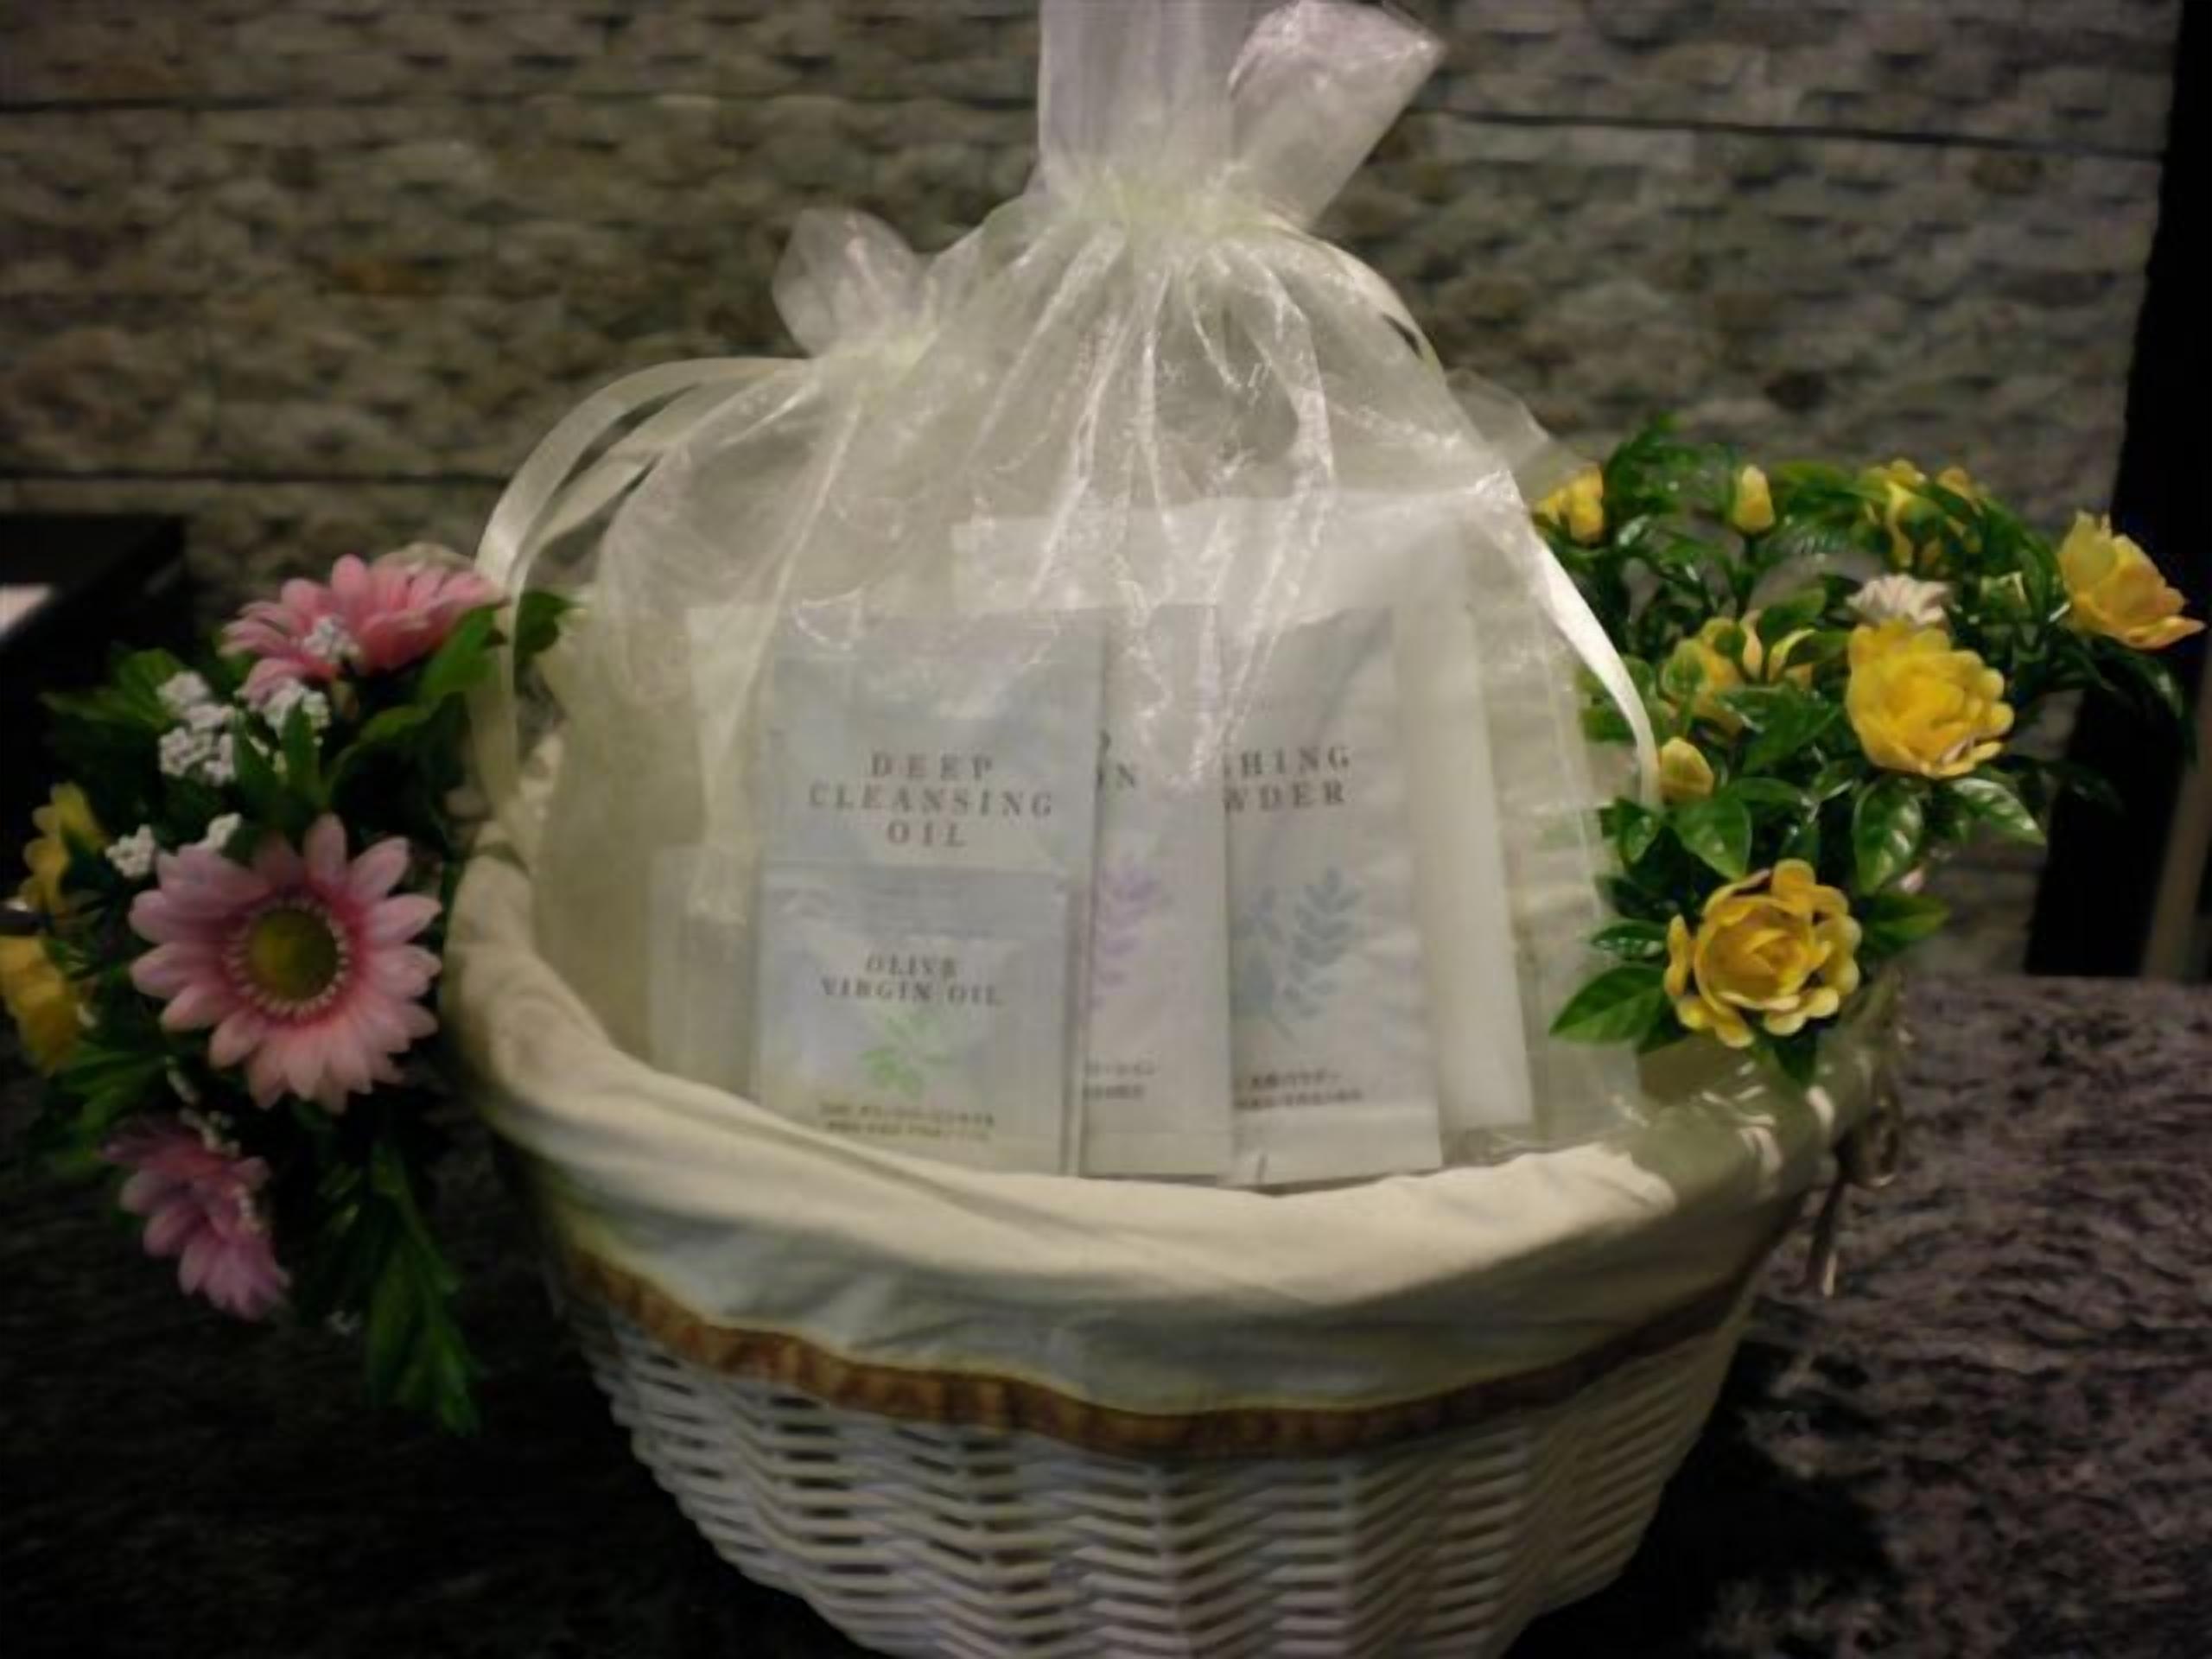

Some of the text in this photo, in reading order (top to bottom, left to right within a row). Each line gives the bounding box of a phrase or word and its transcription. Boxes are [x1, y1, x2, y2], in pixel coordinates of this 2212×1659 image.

[870, 750, 995, 782] DEEP
[1223, 746, 1350, 778] HING
[809, 781, 1052, 818] CLEANSING
[887, 819, 968, 848] OIL
[865, 952, 957, 979] OLIVE
[821, 976, 1005, 1007] VIRGIN OIL
